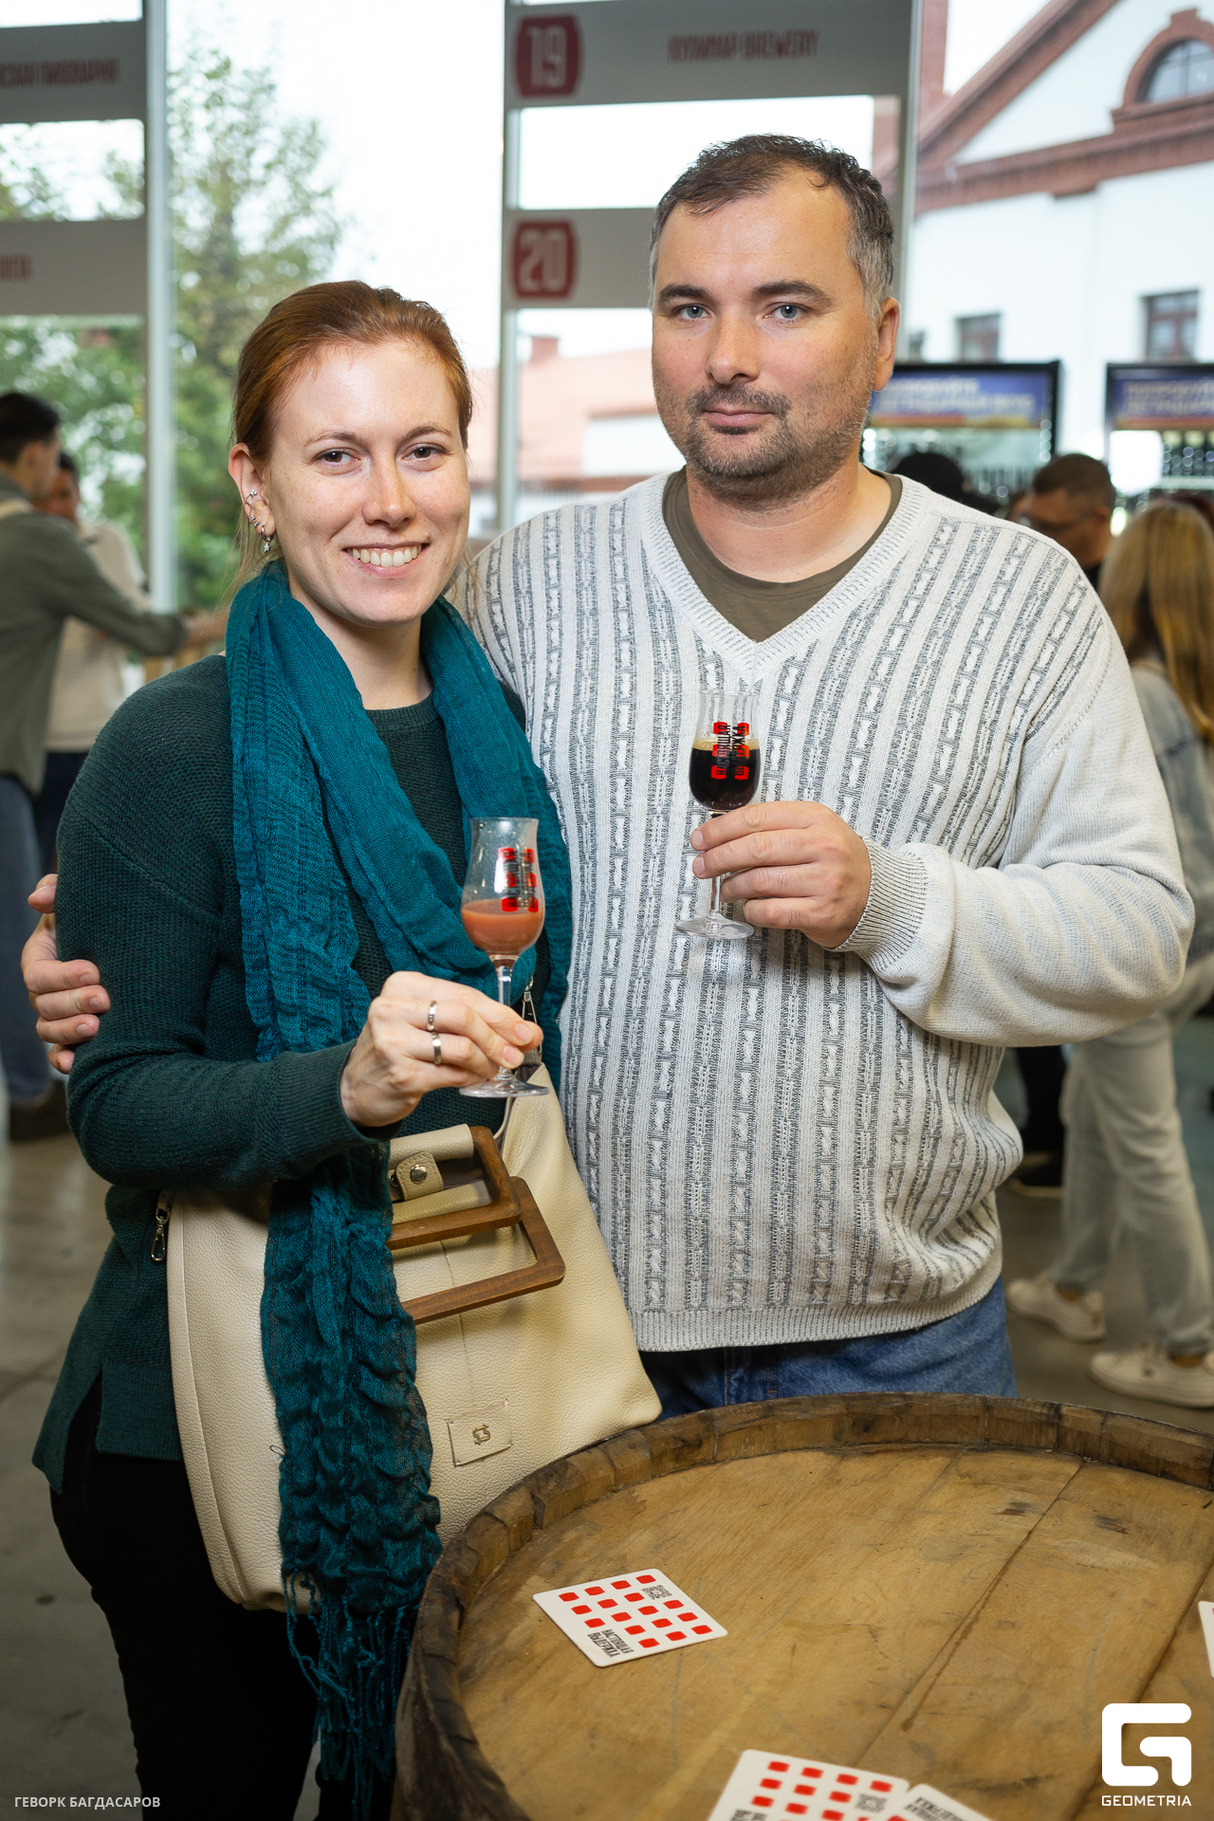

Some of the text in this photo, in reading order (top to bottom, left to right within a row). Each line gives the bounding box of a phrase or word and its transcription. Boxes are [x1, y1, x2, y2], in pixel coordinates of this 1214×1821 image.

[524, 26, 567, 88] 19
[519, 228, 567, 291] 20
[715, 724, 731, 776] НАСТОЯЩАЯ
[587, 1631, 621, 1658] ВЫДЕРЖКА
